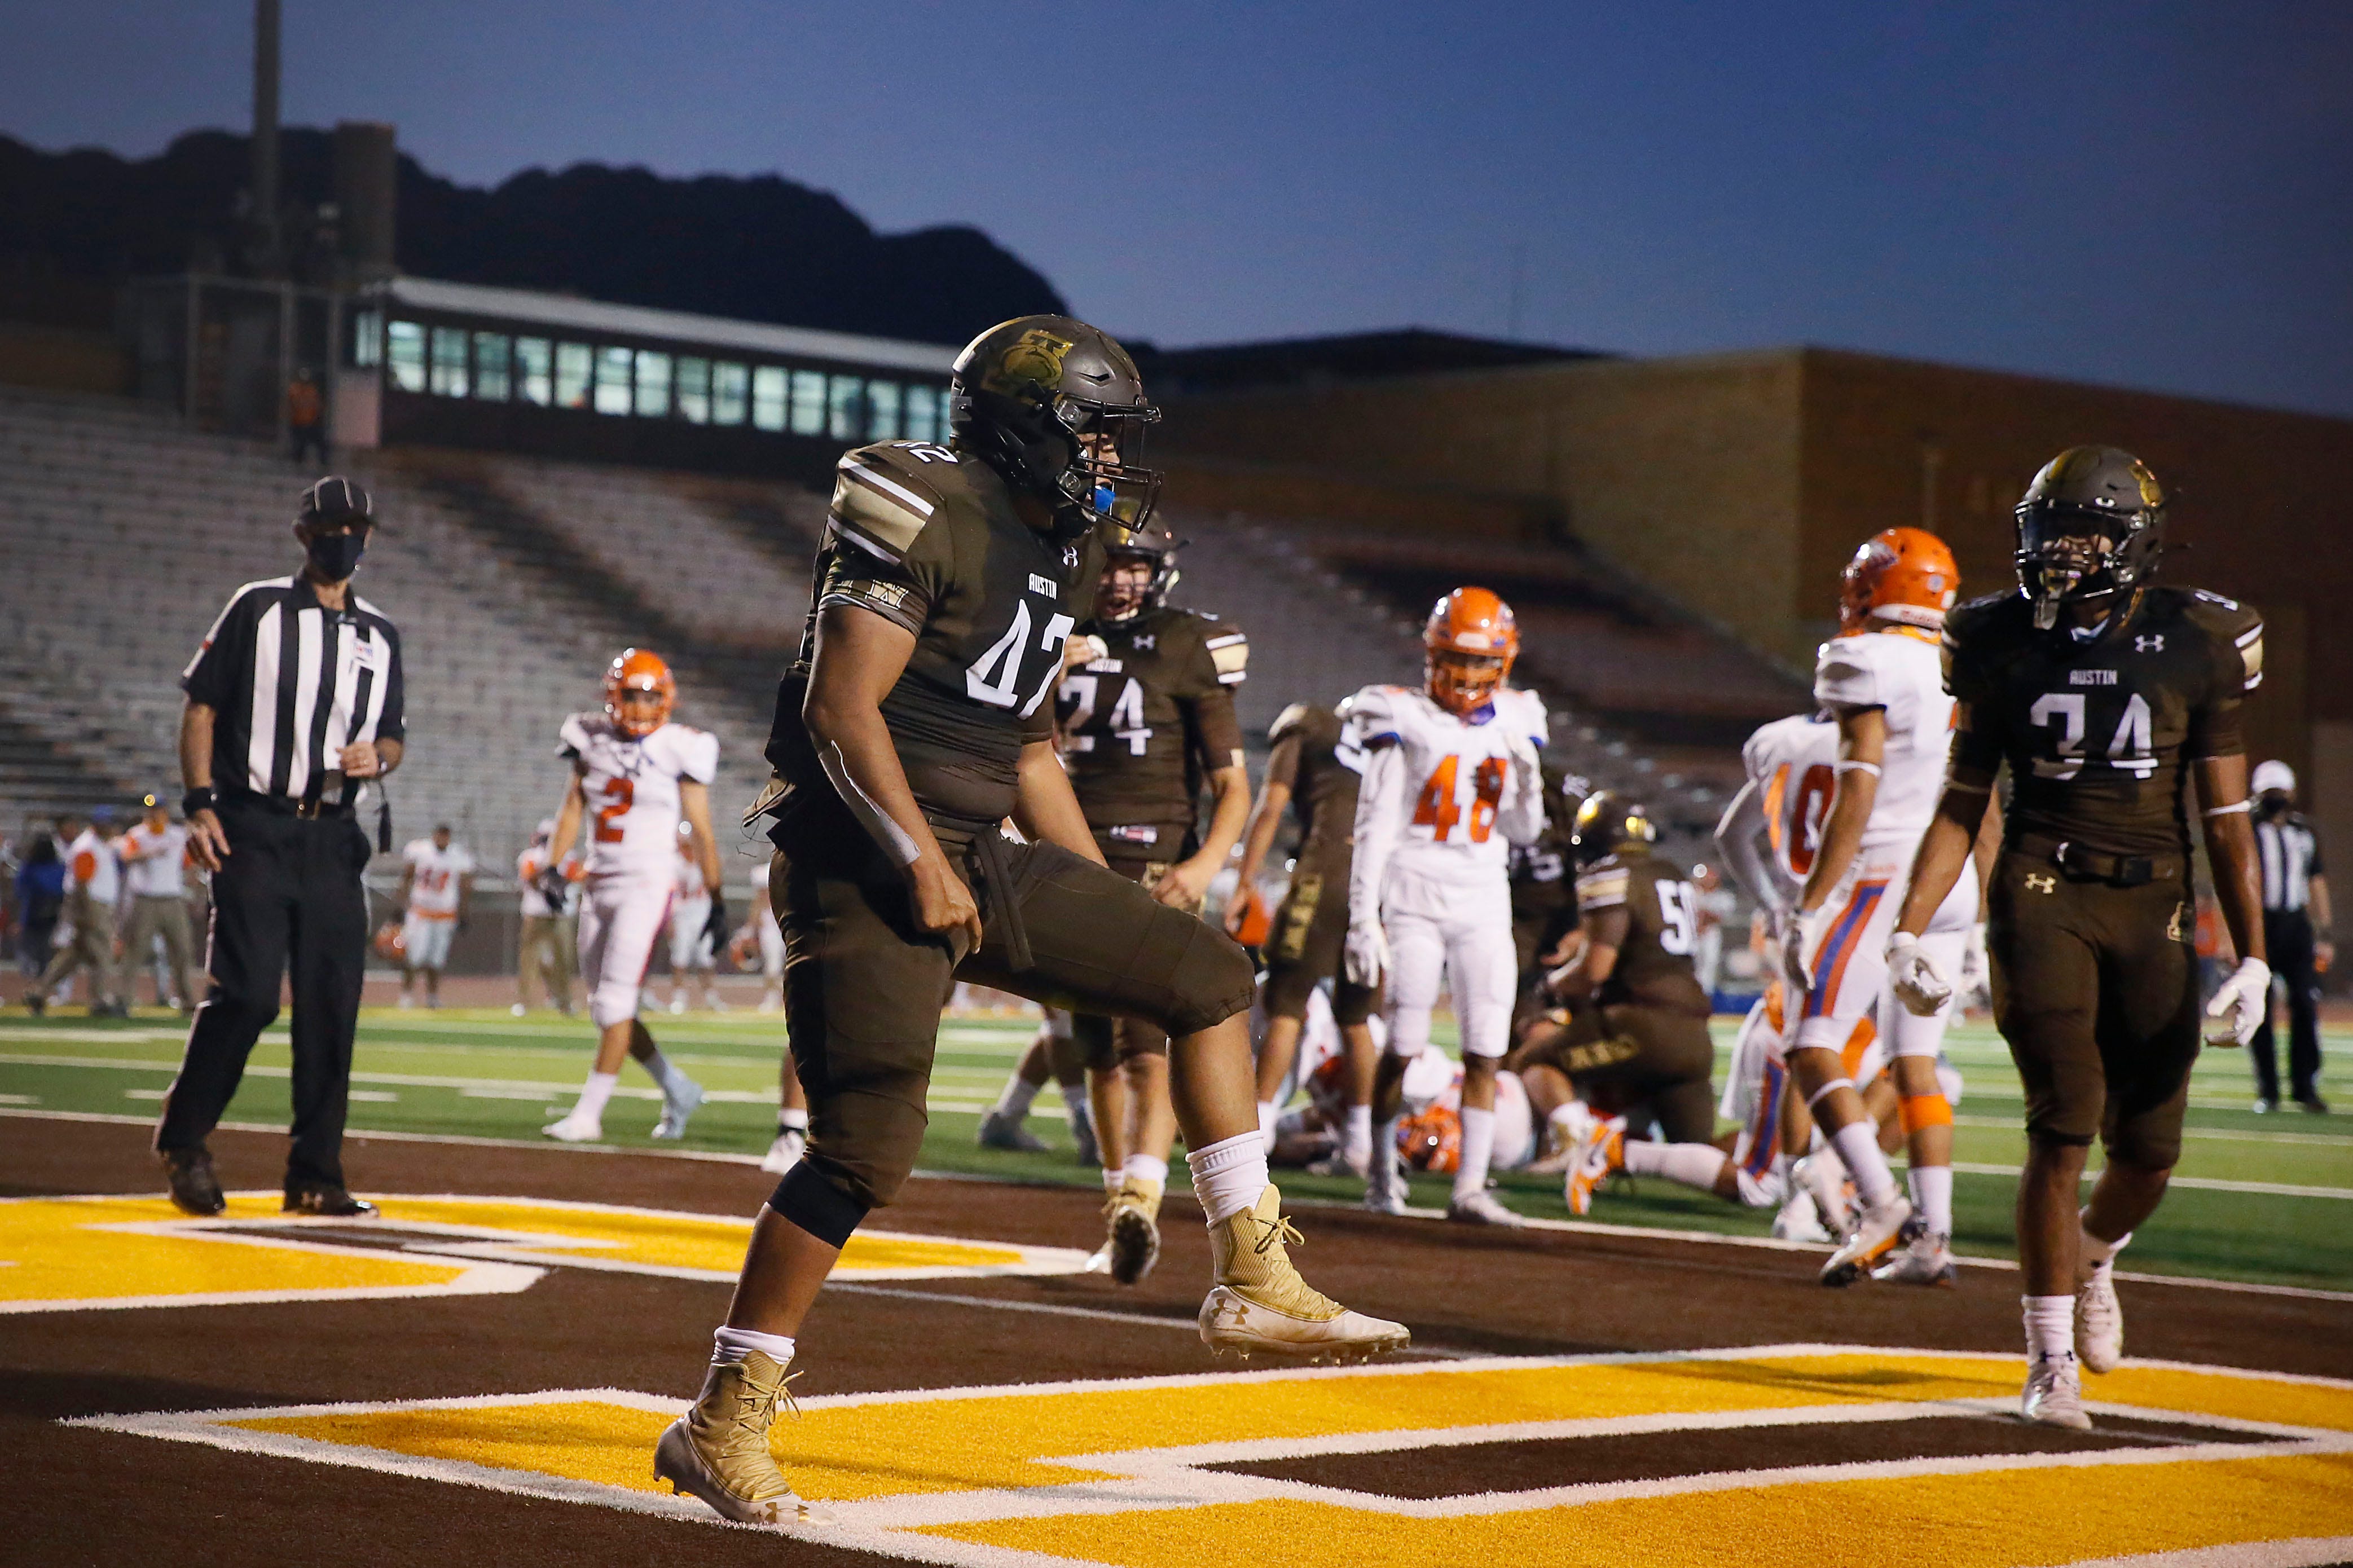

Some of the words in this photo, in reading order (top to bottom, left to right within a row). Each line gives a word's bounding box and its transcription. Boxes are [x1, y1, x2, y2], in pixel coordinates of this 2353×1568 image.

[1029, 572, 1057, 600] AUSTIN
[2069, 670, 2118, 685] AUSTIN
[1058, 676, 1153, 755] 24
[595, 777, 634, 843] 2
